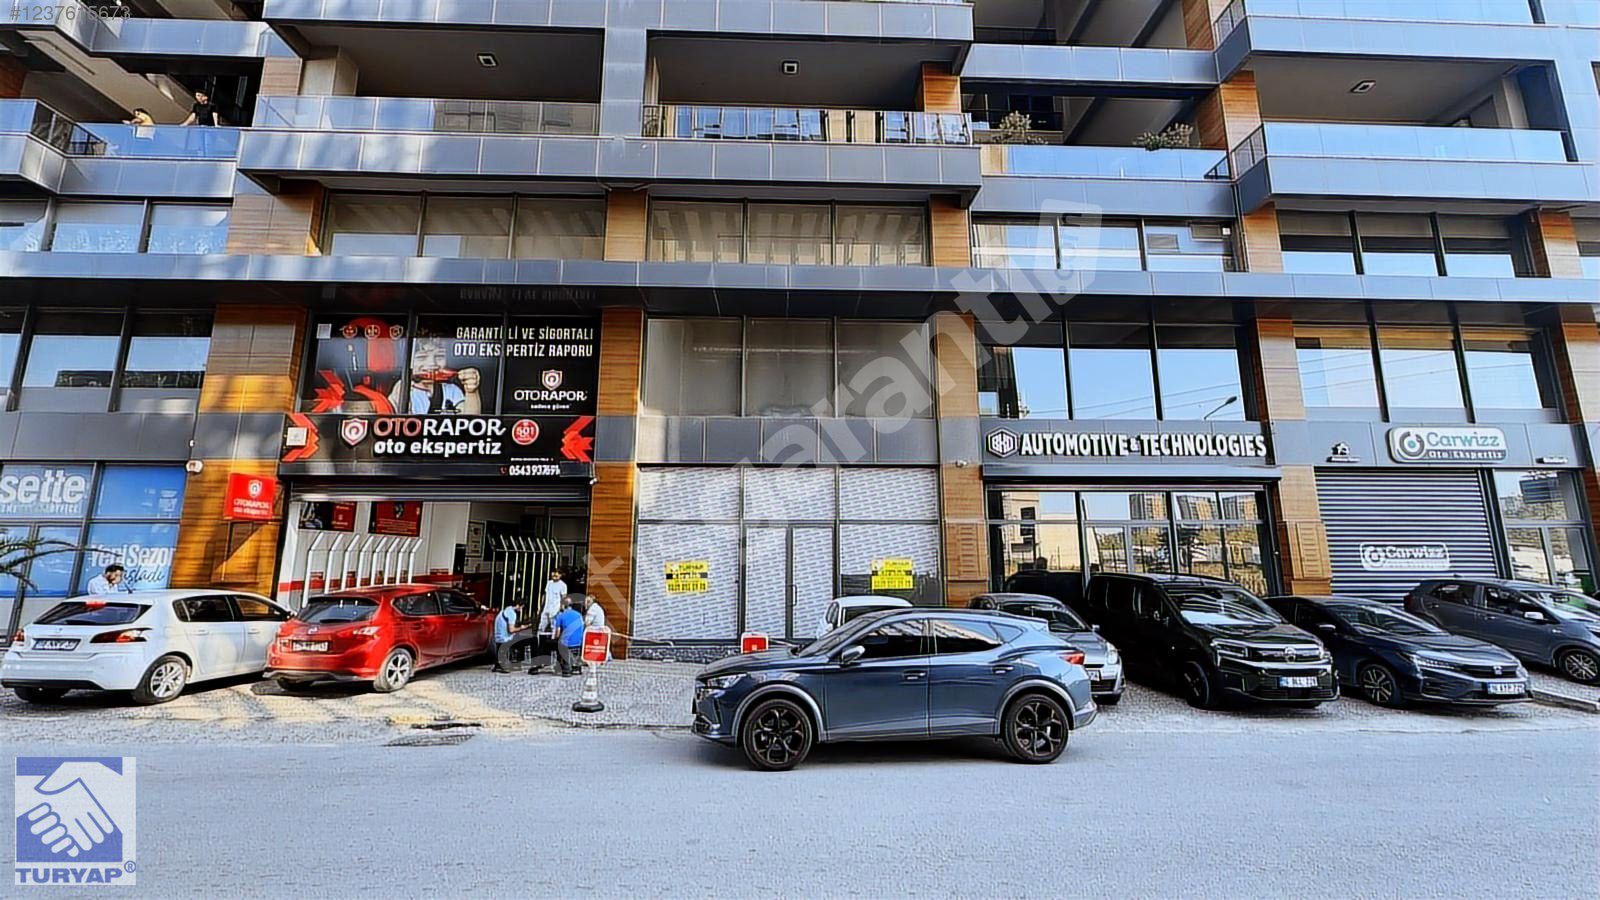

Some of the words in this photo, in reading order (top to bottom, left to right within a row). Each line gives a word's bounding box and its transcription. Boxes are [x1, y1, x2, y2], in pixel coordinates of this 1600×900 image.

[522, 327, 535, 340] VE
[538, 325, 594, 340] SİGORTALI
[454, 343, 476, 357] OTO
[548, 344, 593, 357] RAPORU
[514, 389, 587, 401] OTORAPOR
[373, 417, 507, 437] OTORAPOR
[1020, 432, 1130, 456] AUTOMOTIVE
[1140, 433, 1267, 457] TECHNOLOGIES
[1426, 432, 1500, 447] Carwizz
[374, 438, 406, 454] oto
[410, 438, 502, 458] ekspertiz
[0, 469, 86, 503] sette
[1385, 546, 1446, 558] Carwizz
